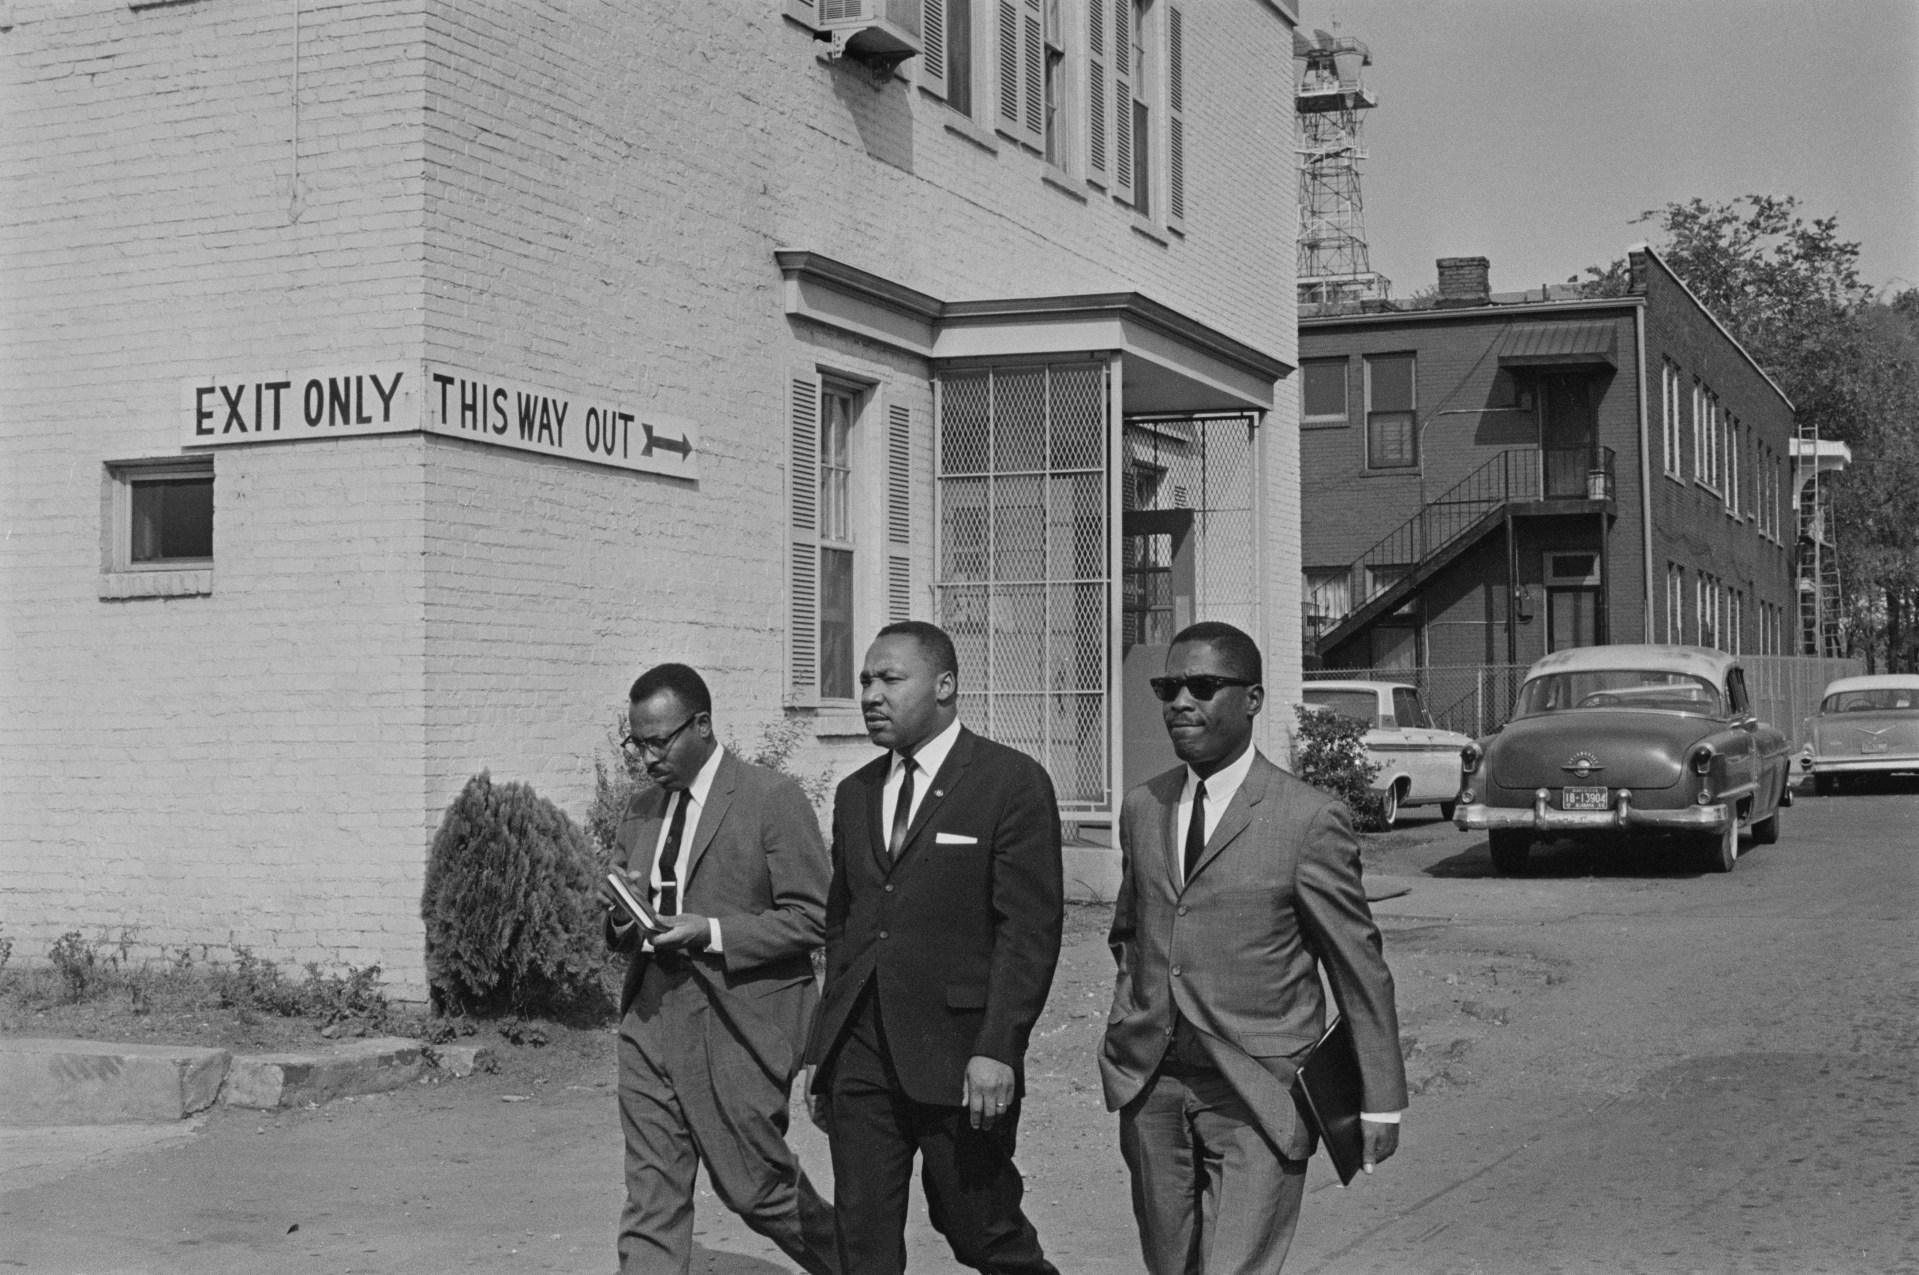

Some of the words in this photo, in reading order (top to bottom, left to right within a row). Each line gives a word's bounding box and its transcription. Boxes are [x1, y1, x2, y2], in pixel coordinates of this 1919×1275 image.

[195, 381, 291, 436] EXIT
[304, 372, 404, 427] ONLY
[433, 373, 508, 435] THIS
[517, 391, 568, 448] WAY
[585, 407, 635, 459] OUT
